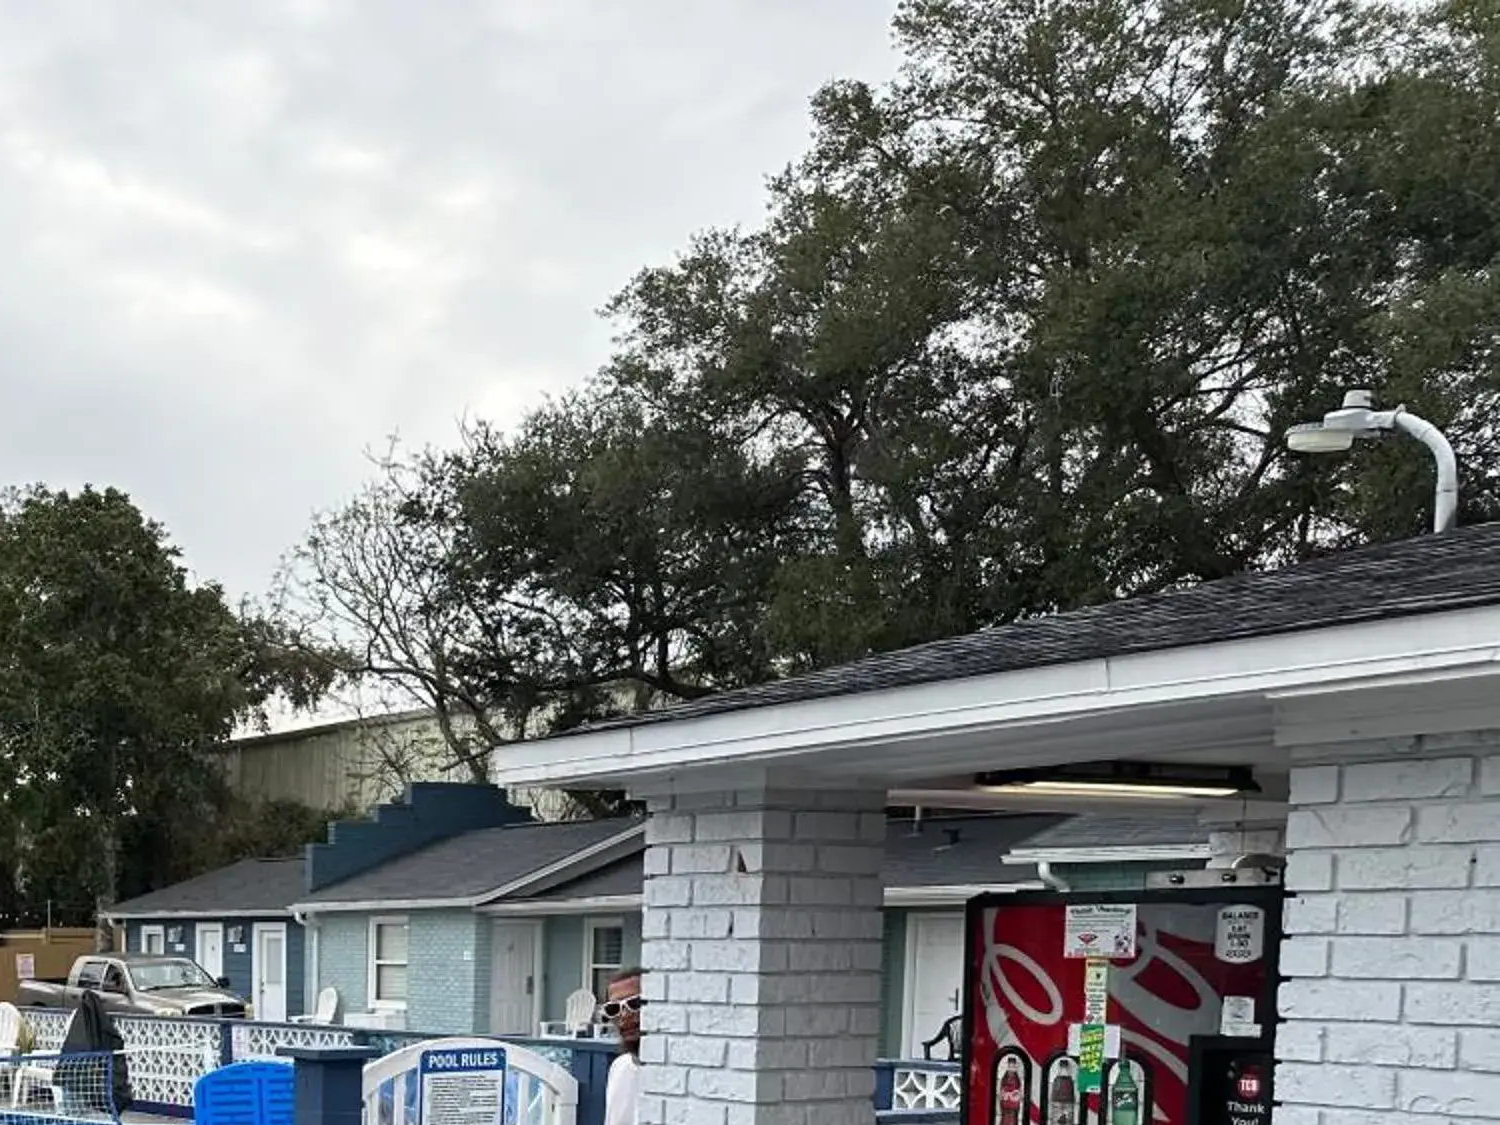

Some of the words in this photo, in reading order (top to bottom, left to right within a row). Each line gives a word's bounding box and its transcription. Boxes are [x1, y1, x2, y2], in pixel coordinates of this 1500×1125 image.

[429, 1054, 458, 1068] POOL
[461, 1052, 498, 1067] RULES
[1227, 1101, 1264, 1113] Thank
